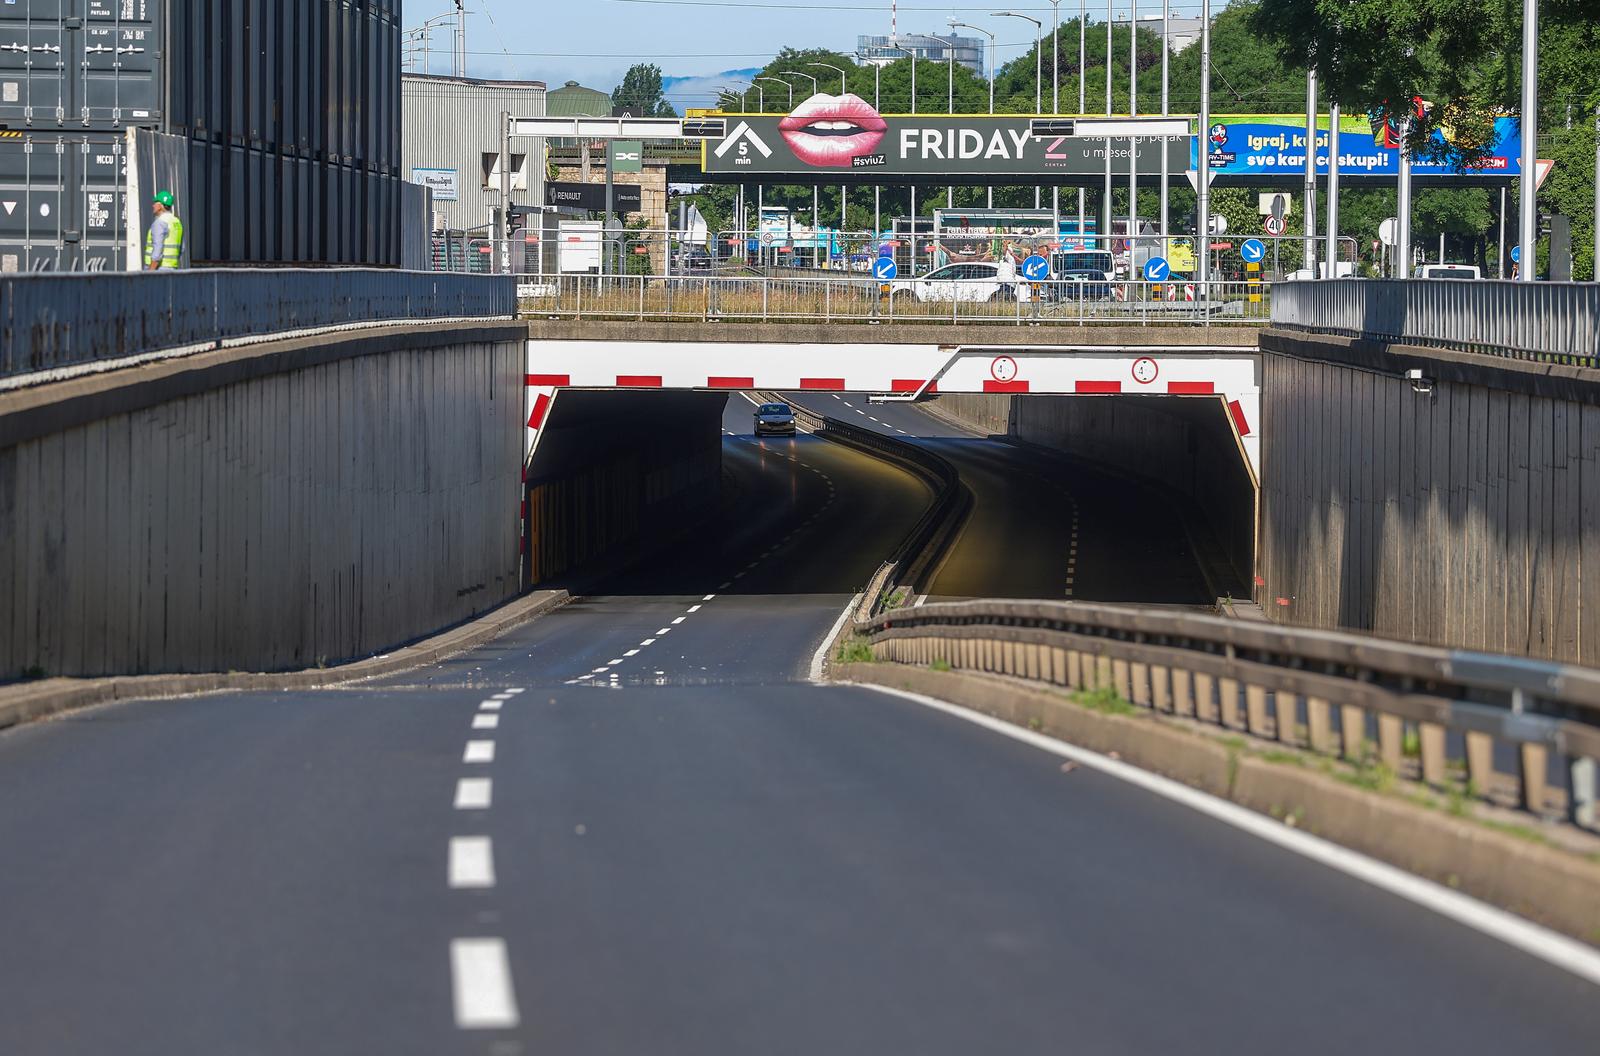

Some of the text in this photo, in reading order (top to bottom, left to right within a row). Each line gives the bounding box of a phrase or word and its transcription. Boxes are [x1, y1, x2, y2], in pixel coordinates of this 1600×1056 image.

[1248, 133, 1289, 150] Igraj,
[738, 142, 748, 155] 5
[1083, 149, 1090, 158] u
[735, 156, 751, 164] min
[853, 155, 885, 166] #sviuZ
[1247, 155, 1275, 166] sve
[1338, 153, 1389, 170] skupi!
[557, 192, 582, 200] RENAULT
